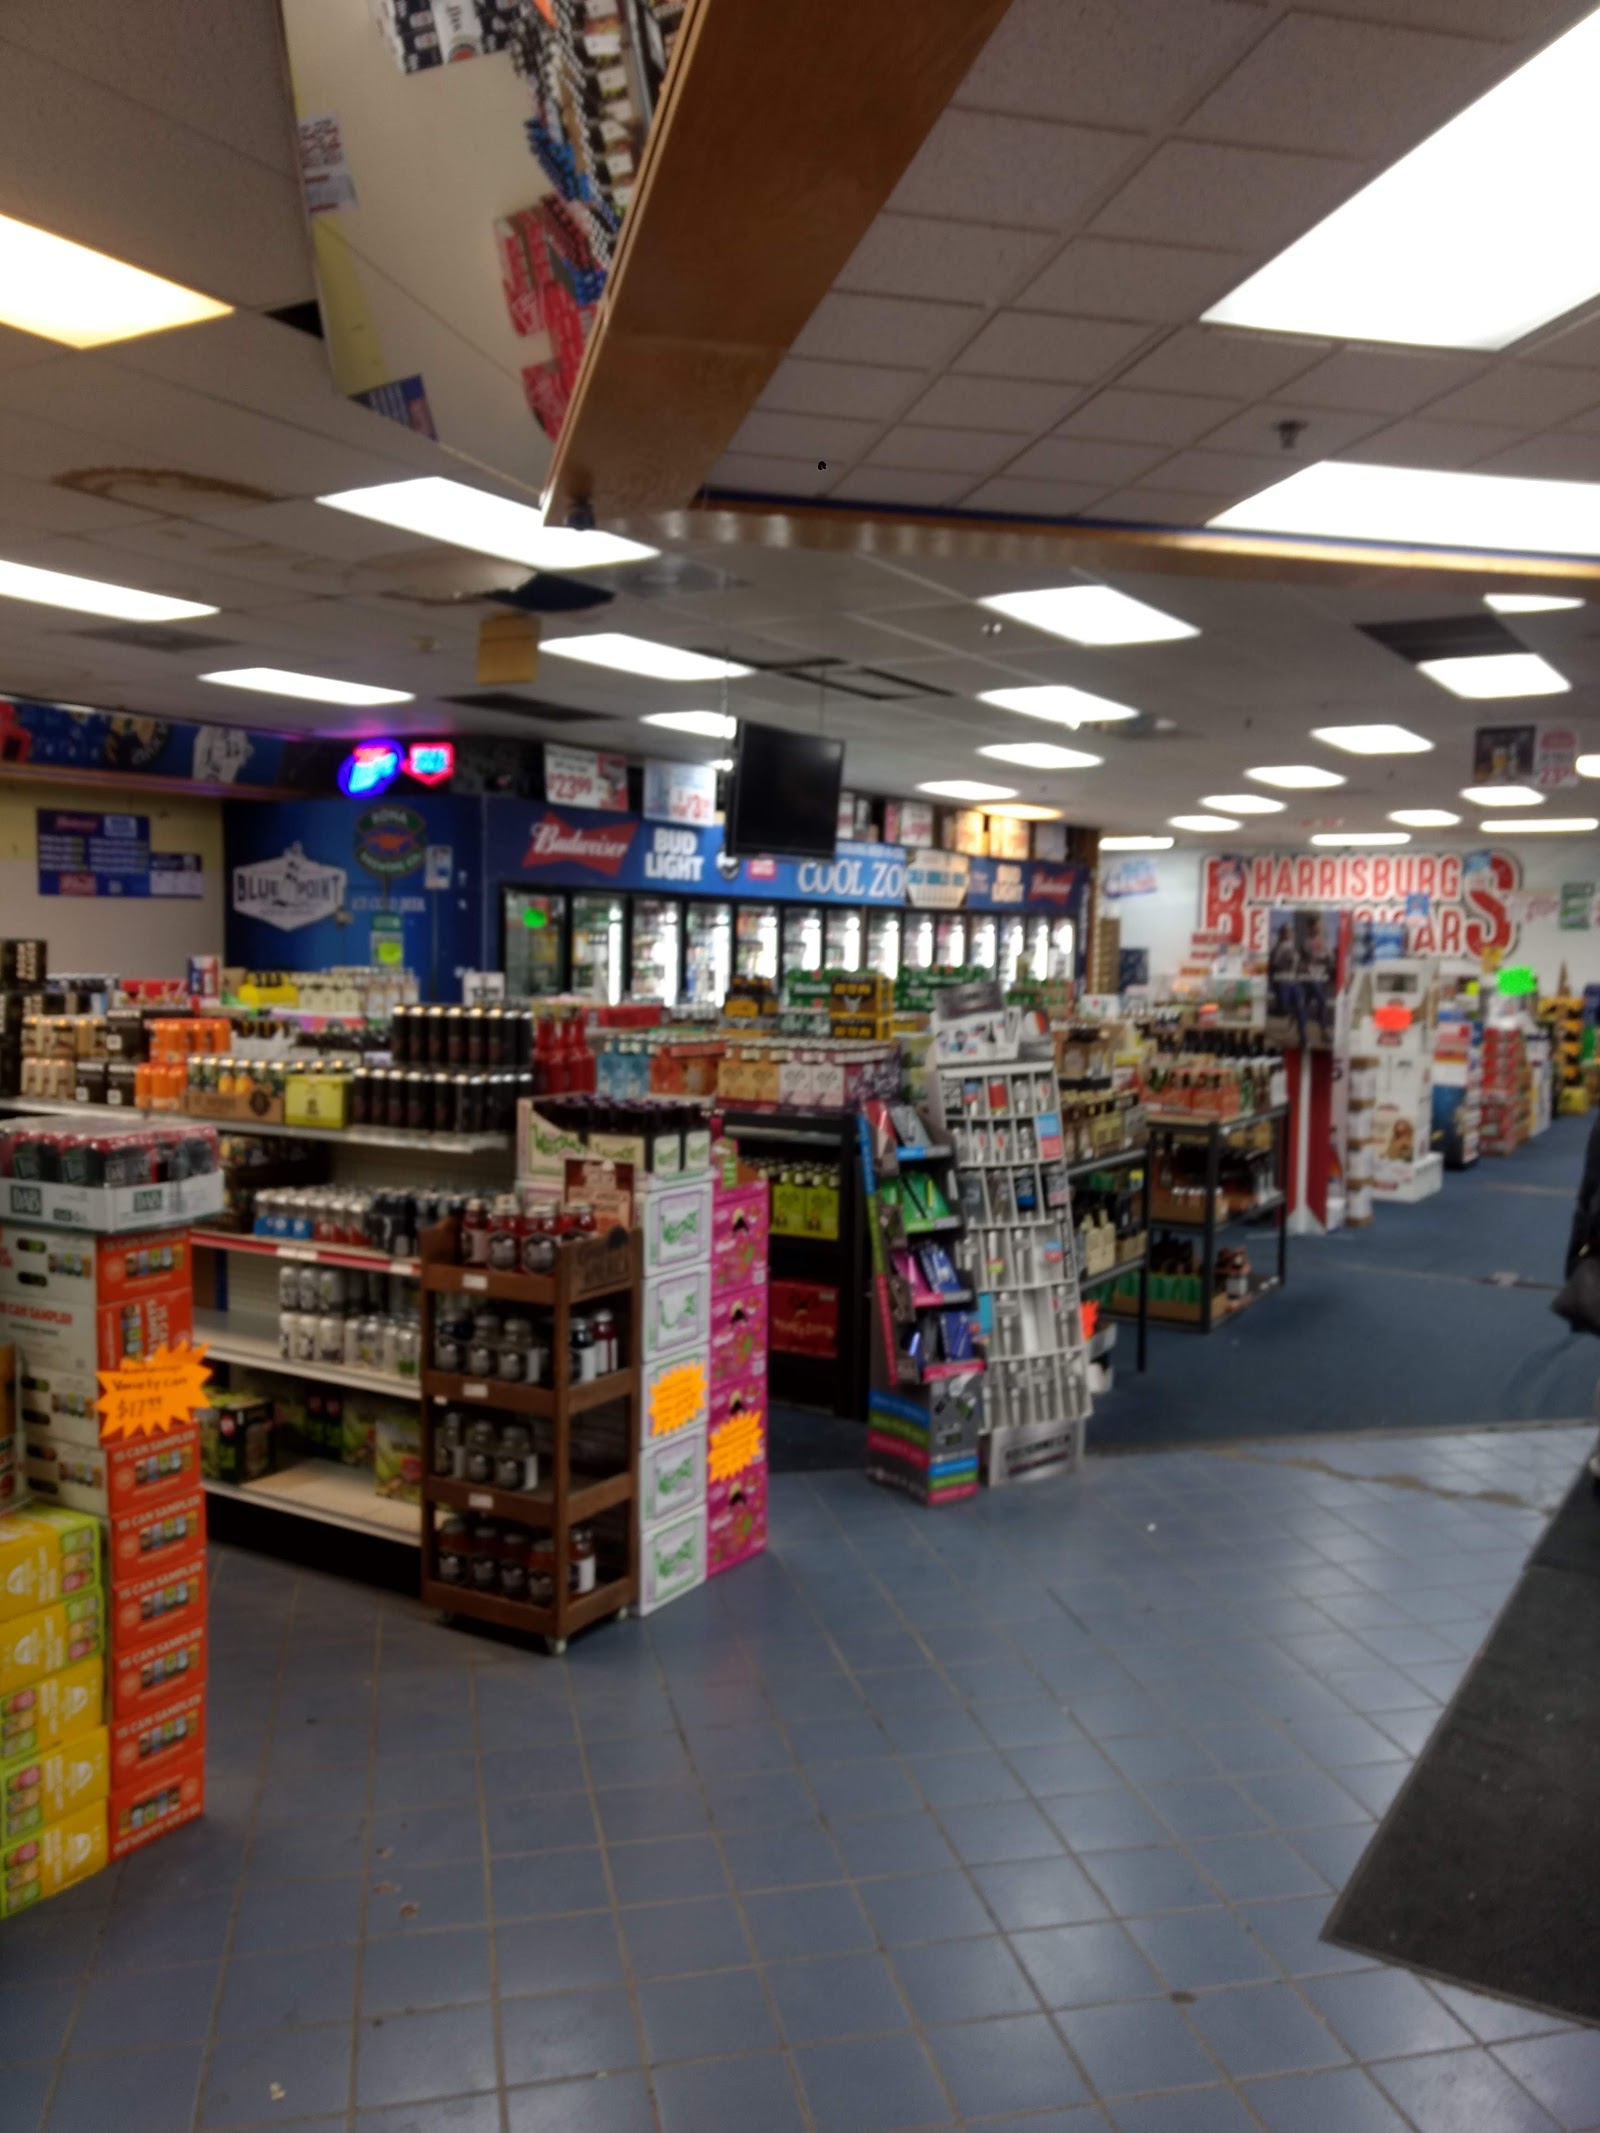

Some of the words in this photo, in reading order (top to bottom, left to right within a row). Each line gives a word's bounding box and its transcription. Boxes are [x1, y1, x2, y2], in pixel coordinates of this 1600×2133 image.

[530, 822, 630, 859] Budweiser
[653, 828, 698, 855] BUD
[644, 853, 704, 882] LIGHT
[797, 858, 864, 896] COOL
[868, 862, 904, 899] ZO
[1252, 856, 1460, 898] HARRISBURG
[236, 874, 280, 902] BLUE
[297, 875, 340, 900] POINT
